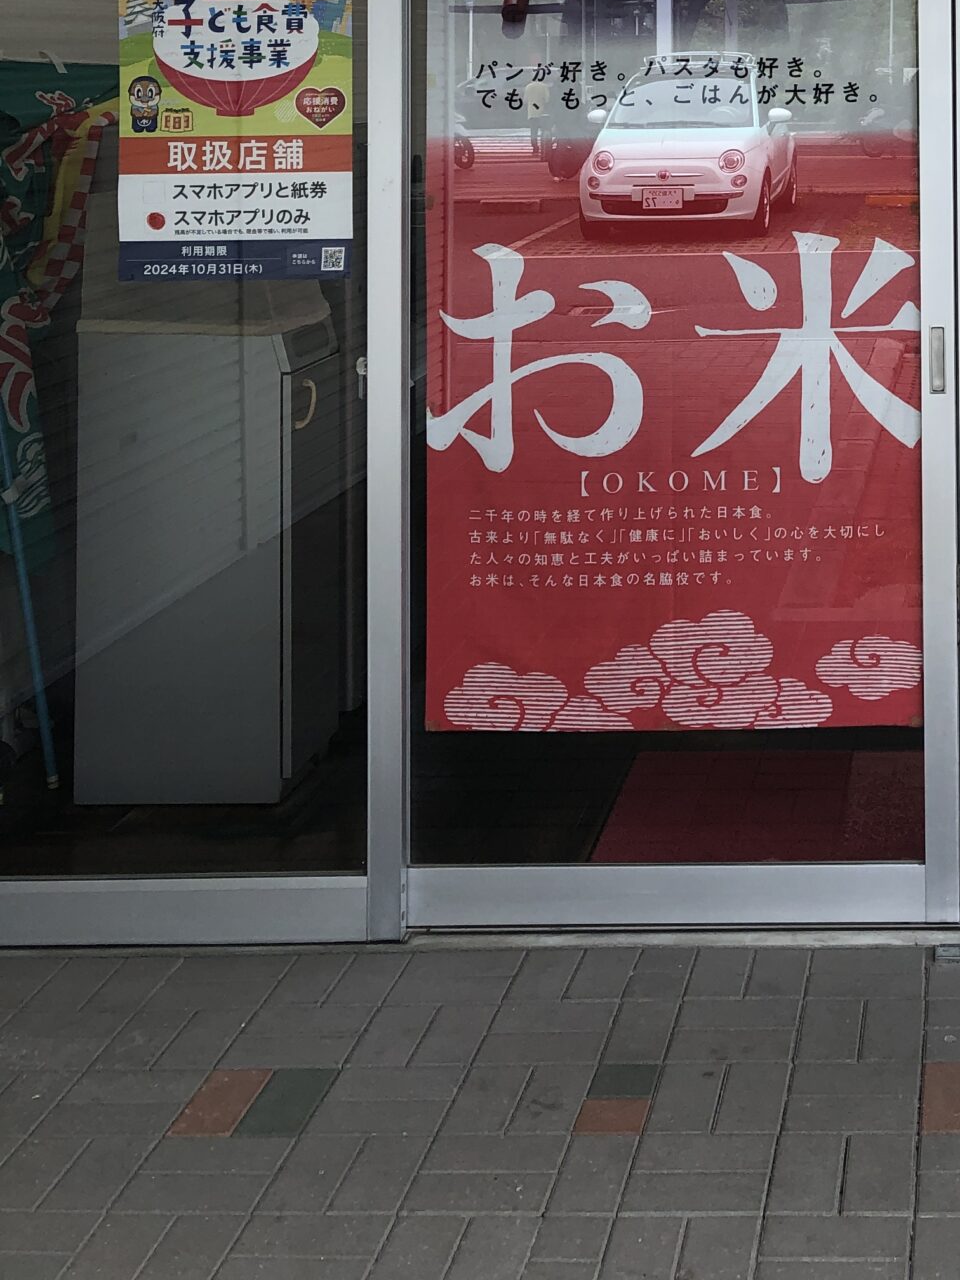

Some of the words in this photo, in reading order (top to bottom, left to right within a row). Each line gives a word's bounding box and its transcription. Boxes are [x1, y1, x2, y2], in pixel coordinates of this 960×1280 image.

[180, 38, 292, 69] 支援事業
[475, 56, 824, 84] パンが好き。パスタも好き。
[475, 83, 880, 110] でも、もっと、ごはんが大好き。
[168, 140, 305, 171] 取扱店舗
[171, 181, 328, 200] スマホアプリと紙券
[173, 207, 311, 227] スマホアプリのみ
[181, 245, 228, 257] 利用期限
[143, 263, 263, 276] 2024年10月31日(木)
[427, 231, 922, 484] お米
[468, 505, 773, 523] 二千年の時を経て作り上げられた日本食。
[468, 523, 887, 545] 古来より「無駄なく」「健康に」「おいしく」の心を大切にし
[469, 547, 822, 567] た人々の知恵と工夫がいっぱい詰まっています。
[469, 570, 734, 587] お米は、そんな日本食の名脇役です。
